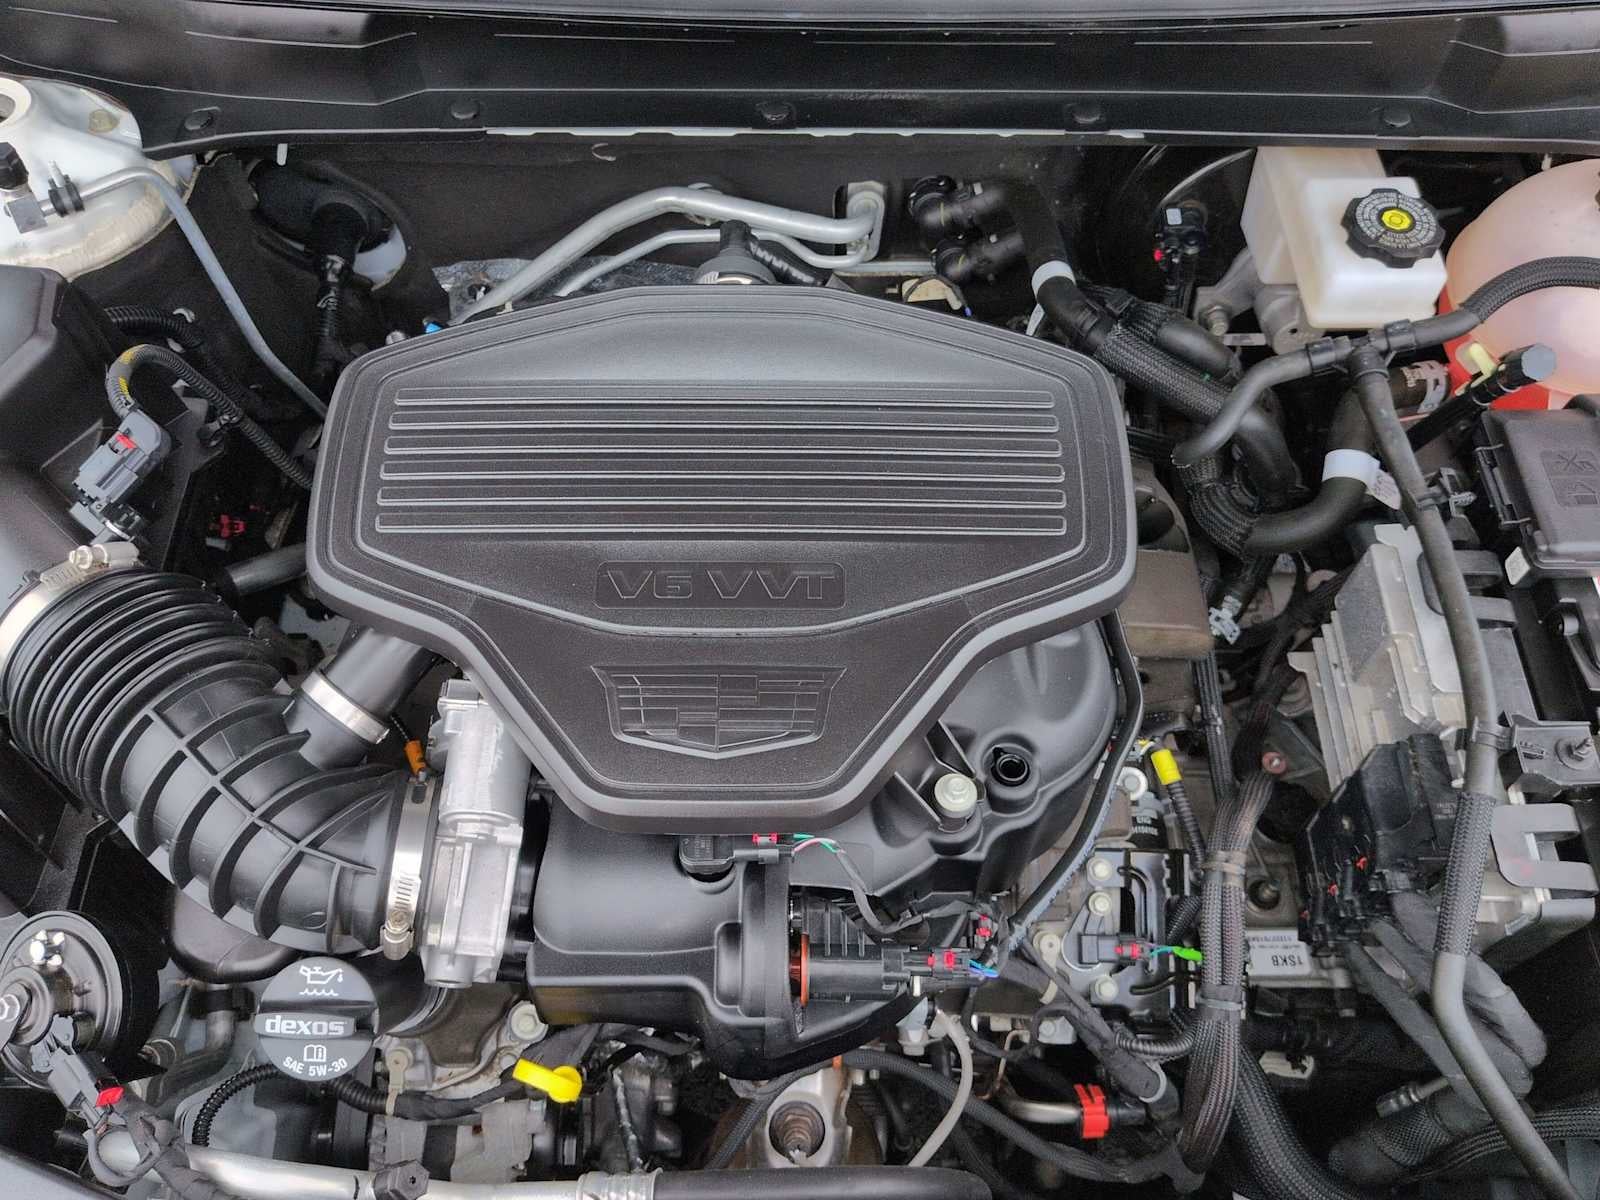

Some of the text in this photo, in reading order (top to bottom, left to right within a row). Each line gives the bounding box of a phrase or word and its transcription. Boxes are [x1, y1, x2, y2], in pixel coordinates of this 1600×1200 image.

[606, 569, 836, 600] V6 VVT
[264, 1014, 345, 1036] dexos
[282, 1055, 348, 1077] SAE 5W-30
